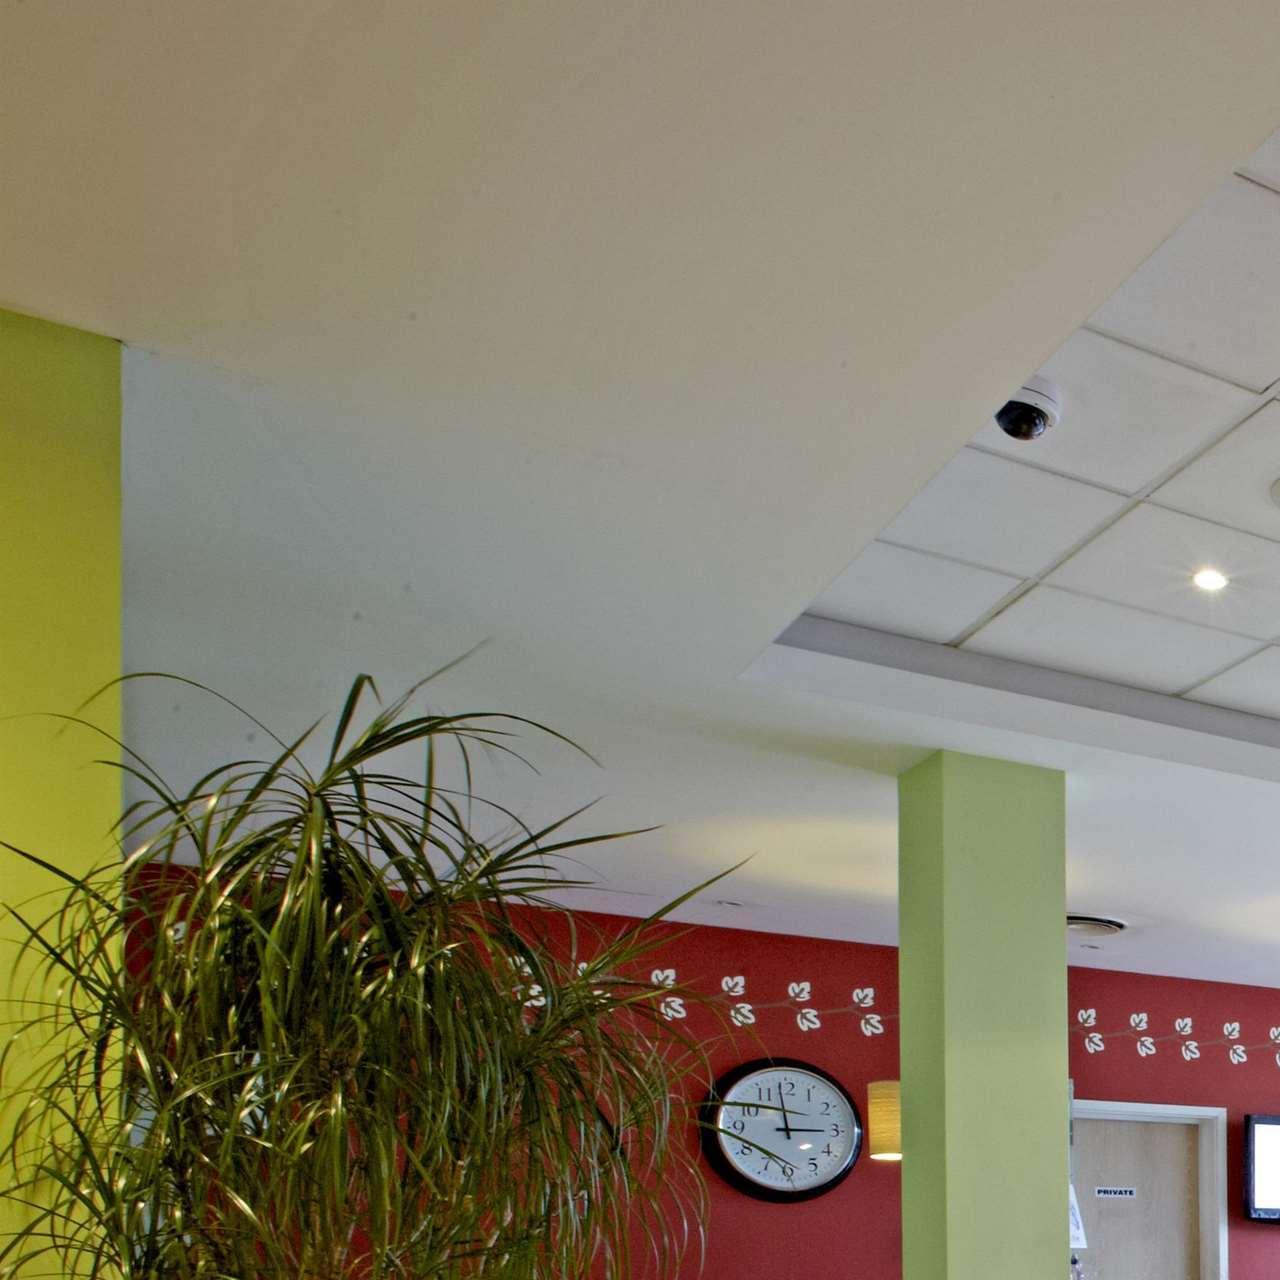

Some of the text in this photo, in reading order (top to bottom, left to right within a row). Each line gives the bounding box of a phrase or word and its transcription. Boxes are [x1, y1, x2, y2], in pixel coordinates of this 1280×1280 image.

[757, 1087, 773, 1102] 11
[777, 1082, 796, 1097] 2
[806, 1087, 813, 1103] 1
[820, 1102, 831, 1116] 2
[732, 1120, 746, 1135] 9
[829, 1123, 840, 1138] 3
[821, 1143, 833, 1157] 4
[807, 1157, 819, 1173] 5
[1096, 1188, 1135, 1196] PRIVATE
